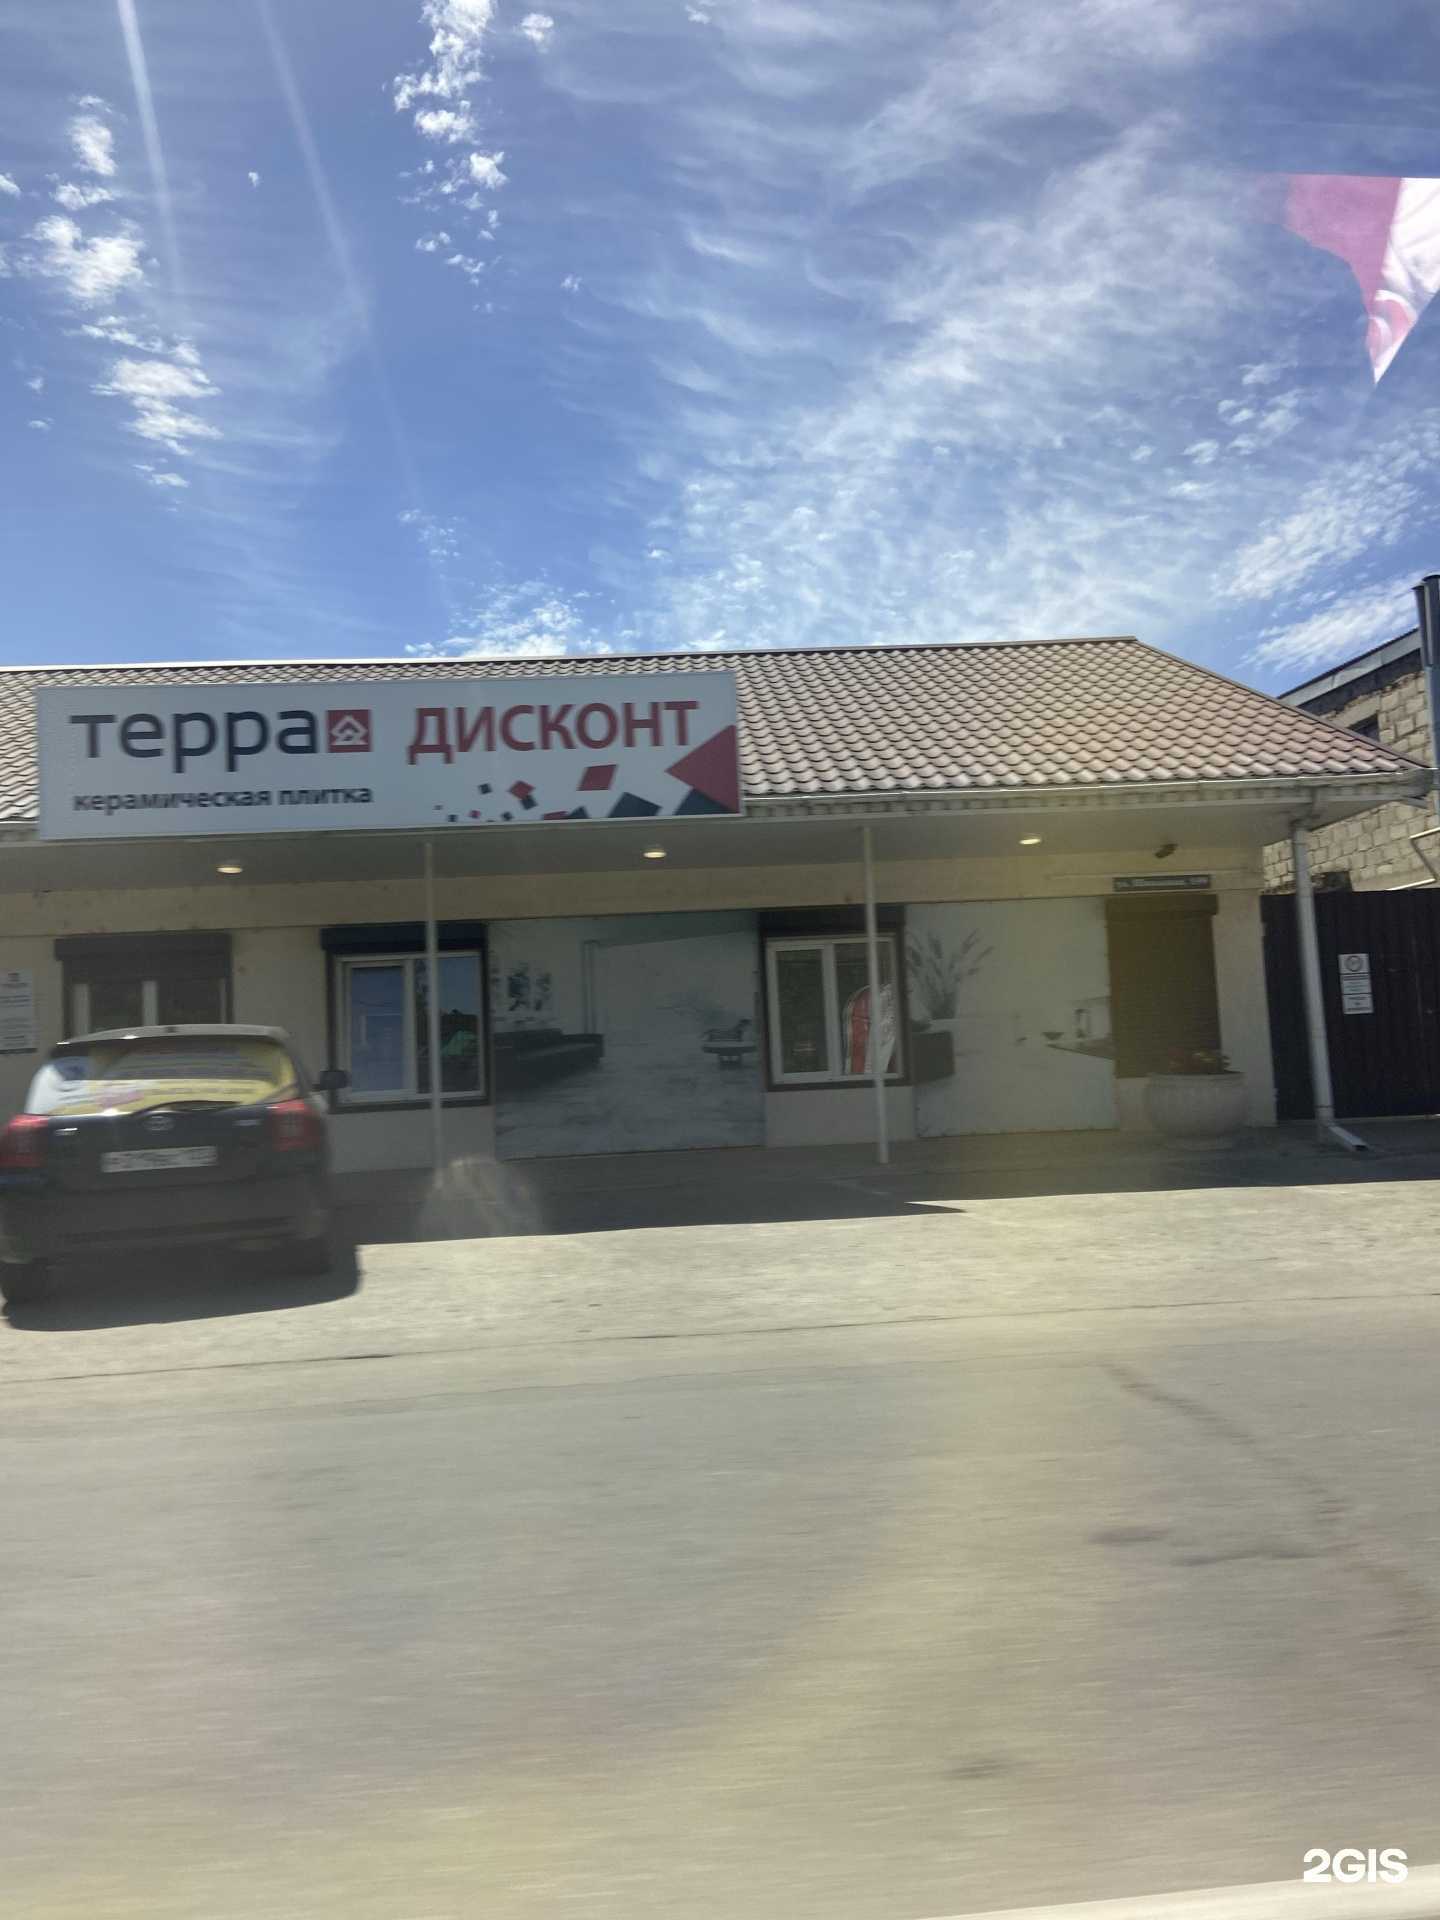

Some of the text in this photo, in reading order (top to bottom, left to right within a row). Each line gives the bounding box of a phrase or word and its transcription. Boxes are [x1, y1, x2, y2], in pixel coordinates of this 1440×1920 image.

[69, 708, 319, 772] терра
[407, 700, 699, 765] ДИСКОНТ
[73, 786, 373, 814] керамическая плитка
